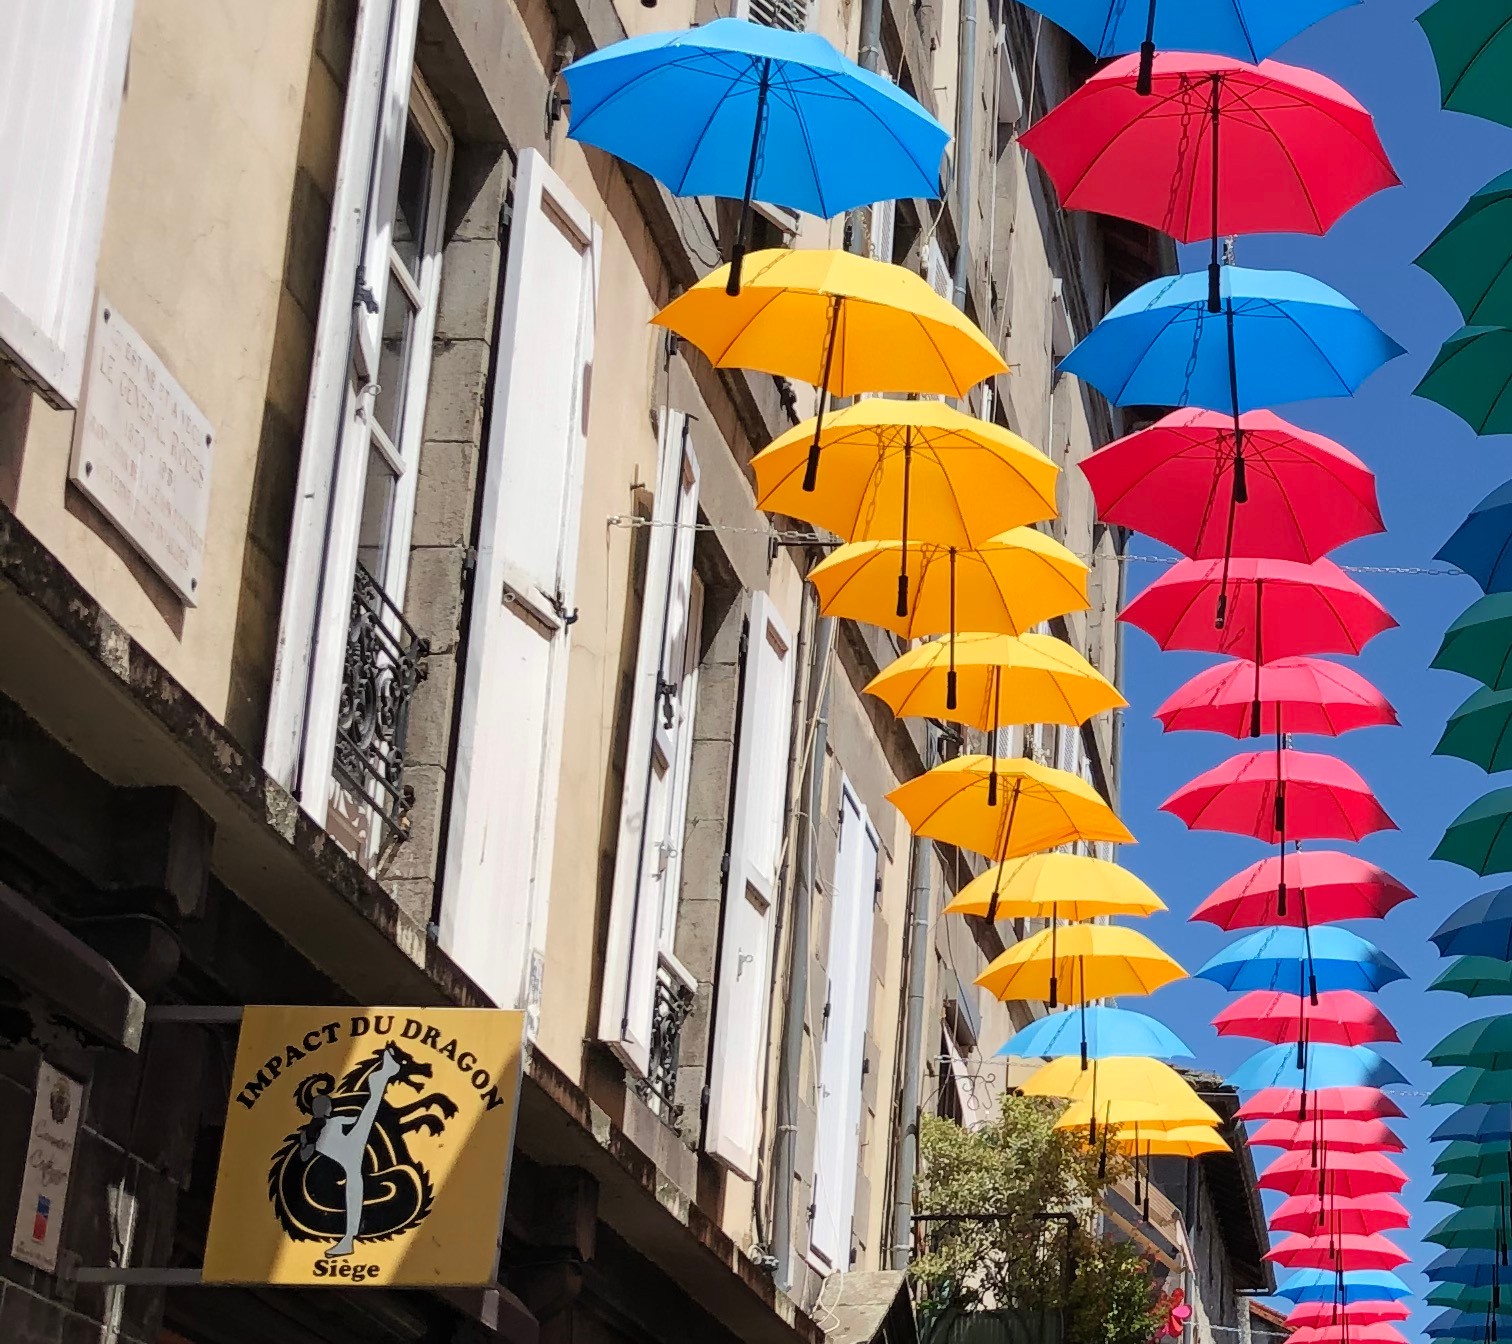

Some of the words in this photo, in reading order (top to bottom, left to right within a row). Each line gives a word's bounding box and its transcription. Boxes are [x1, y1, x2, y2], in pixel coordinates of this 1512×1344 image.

[236, 1022, 341, 1110] IMPACT
[350, 1015, 395, 1037] DU
[400, 1018, 505, 1111] DRAGON
[312, 1259, 380, 1282] Siège
